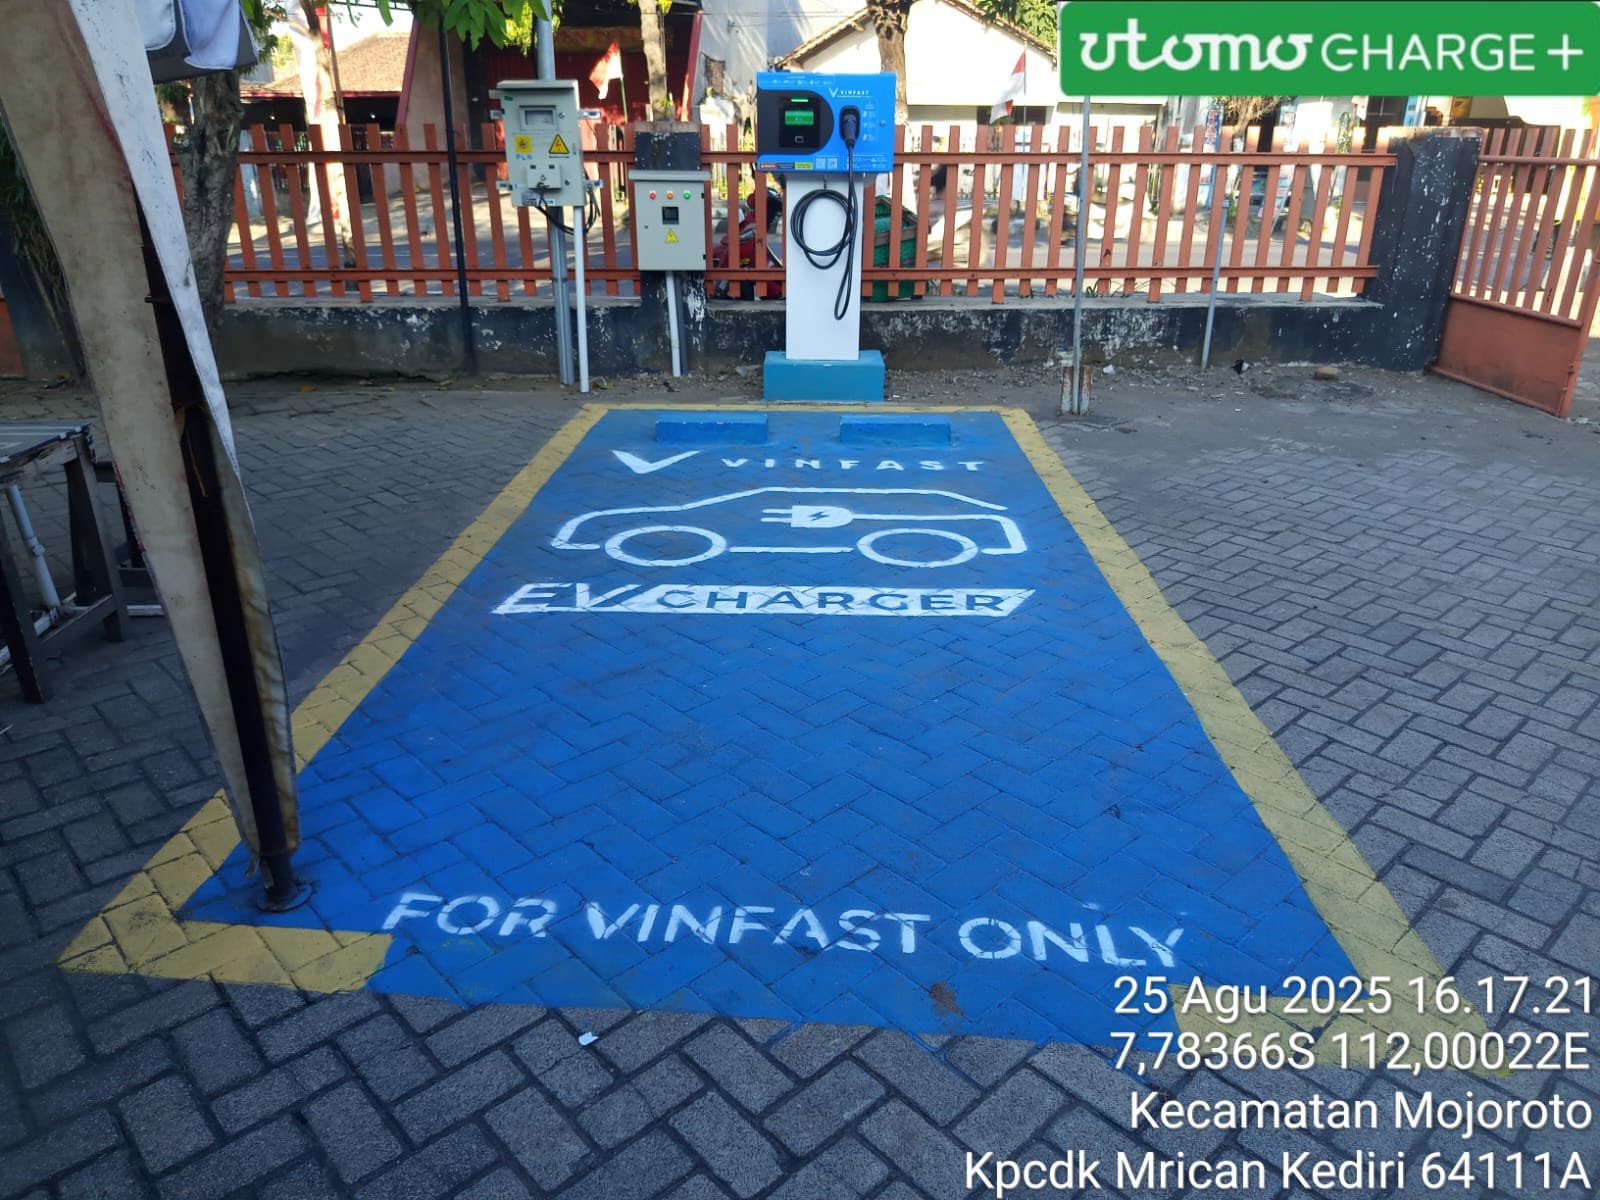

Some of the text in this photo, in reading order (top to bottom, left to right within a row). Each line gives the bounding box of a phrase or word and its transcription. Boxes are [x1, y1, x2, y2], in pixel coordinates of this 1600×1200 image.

[720, 457, 985, 473] VINFAST
[495, 583, 1004, 612] EV CHARGER
[382, 892, 1185, 968] FOR VINFAST ONLY
